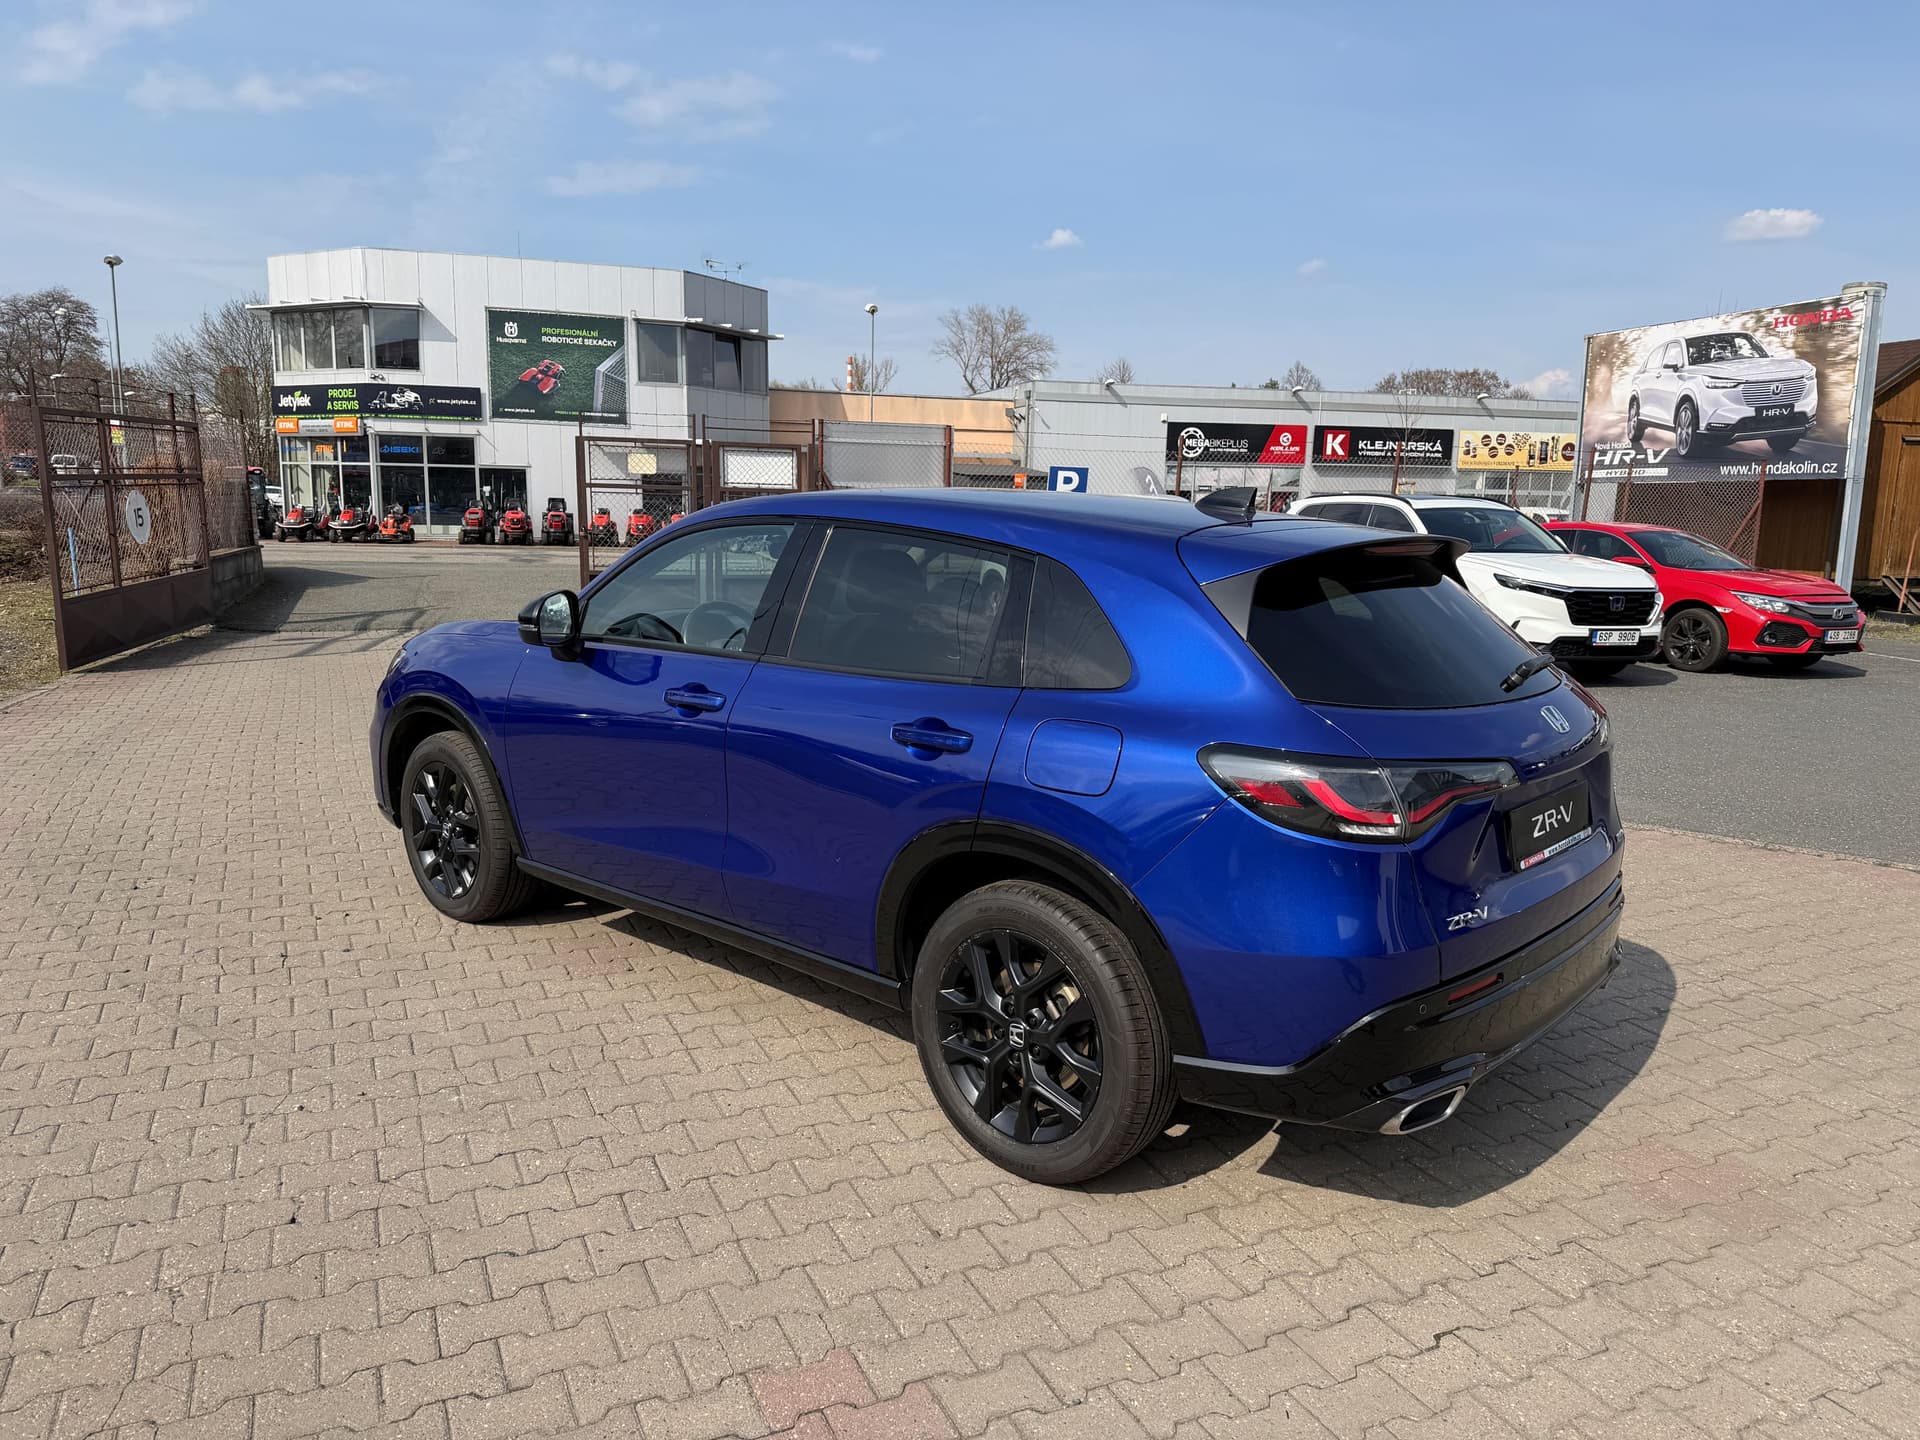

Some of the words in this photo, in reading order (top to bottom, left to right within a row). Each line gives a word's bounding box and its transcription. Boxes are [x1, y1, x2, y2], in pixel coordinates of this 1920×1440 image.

[1772, 307, 1854, 329] HONDA
[541, 327, 599, 337] PROFESIONÁLNÍ
[496, 336, 527, 345] Husqvarna
[541, 336, 583, 345] ROBOTICKÉ
[584, 337, 618, 347] SEKAČKY
[328, 388, 357, 399] PRODEJ
[326, 401, 333, 411] A
[333, 400, 360, 410] SERVIS
[1762, 407, 1791, 417] HR-V
[1185, 438, 1249, 449] MEGABIKEPLUS
[1325, 433, 1346, 456] K
[1611, 440, 1632, 449] Honda
[390, 446, 420, 454] ISEKI
[1593, 447, 1670, 466] HR-V
[1056, 470, 1080, 492] P
[133, 507, 145, 528] 15
[1617, 631, 1637, 642] 9906
[1531, 800, 1574, 838] ZR-V
[1446, 905, 1488, 931] ZR-V
